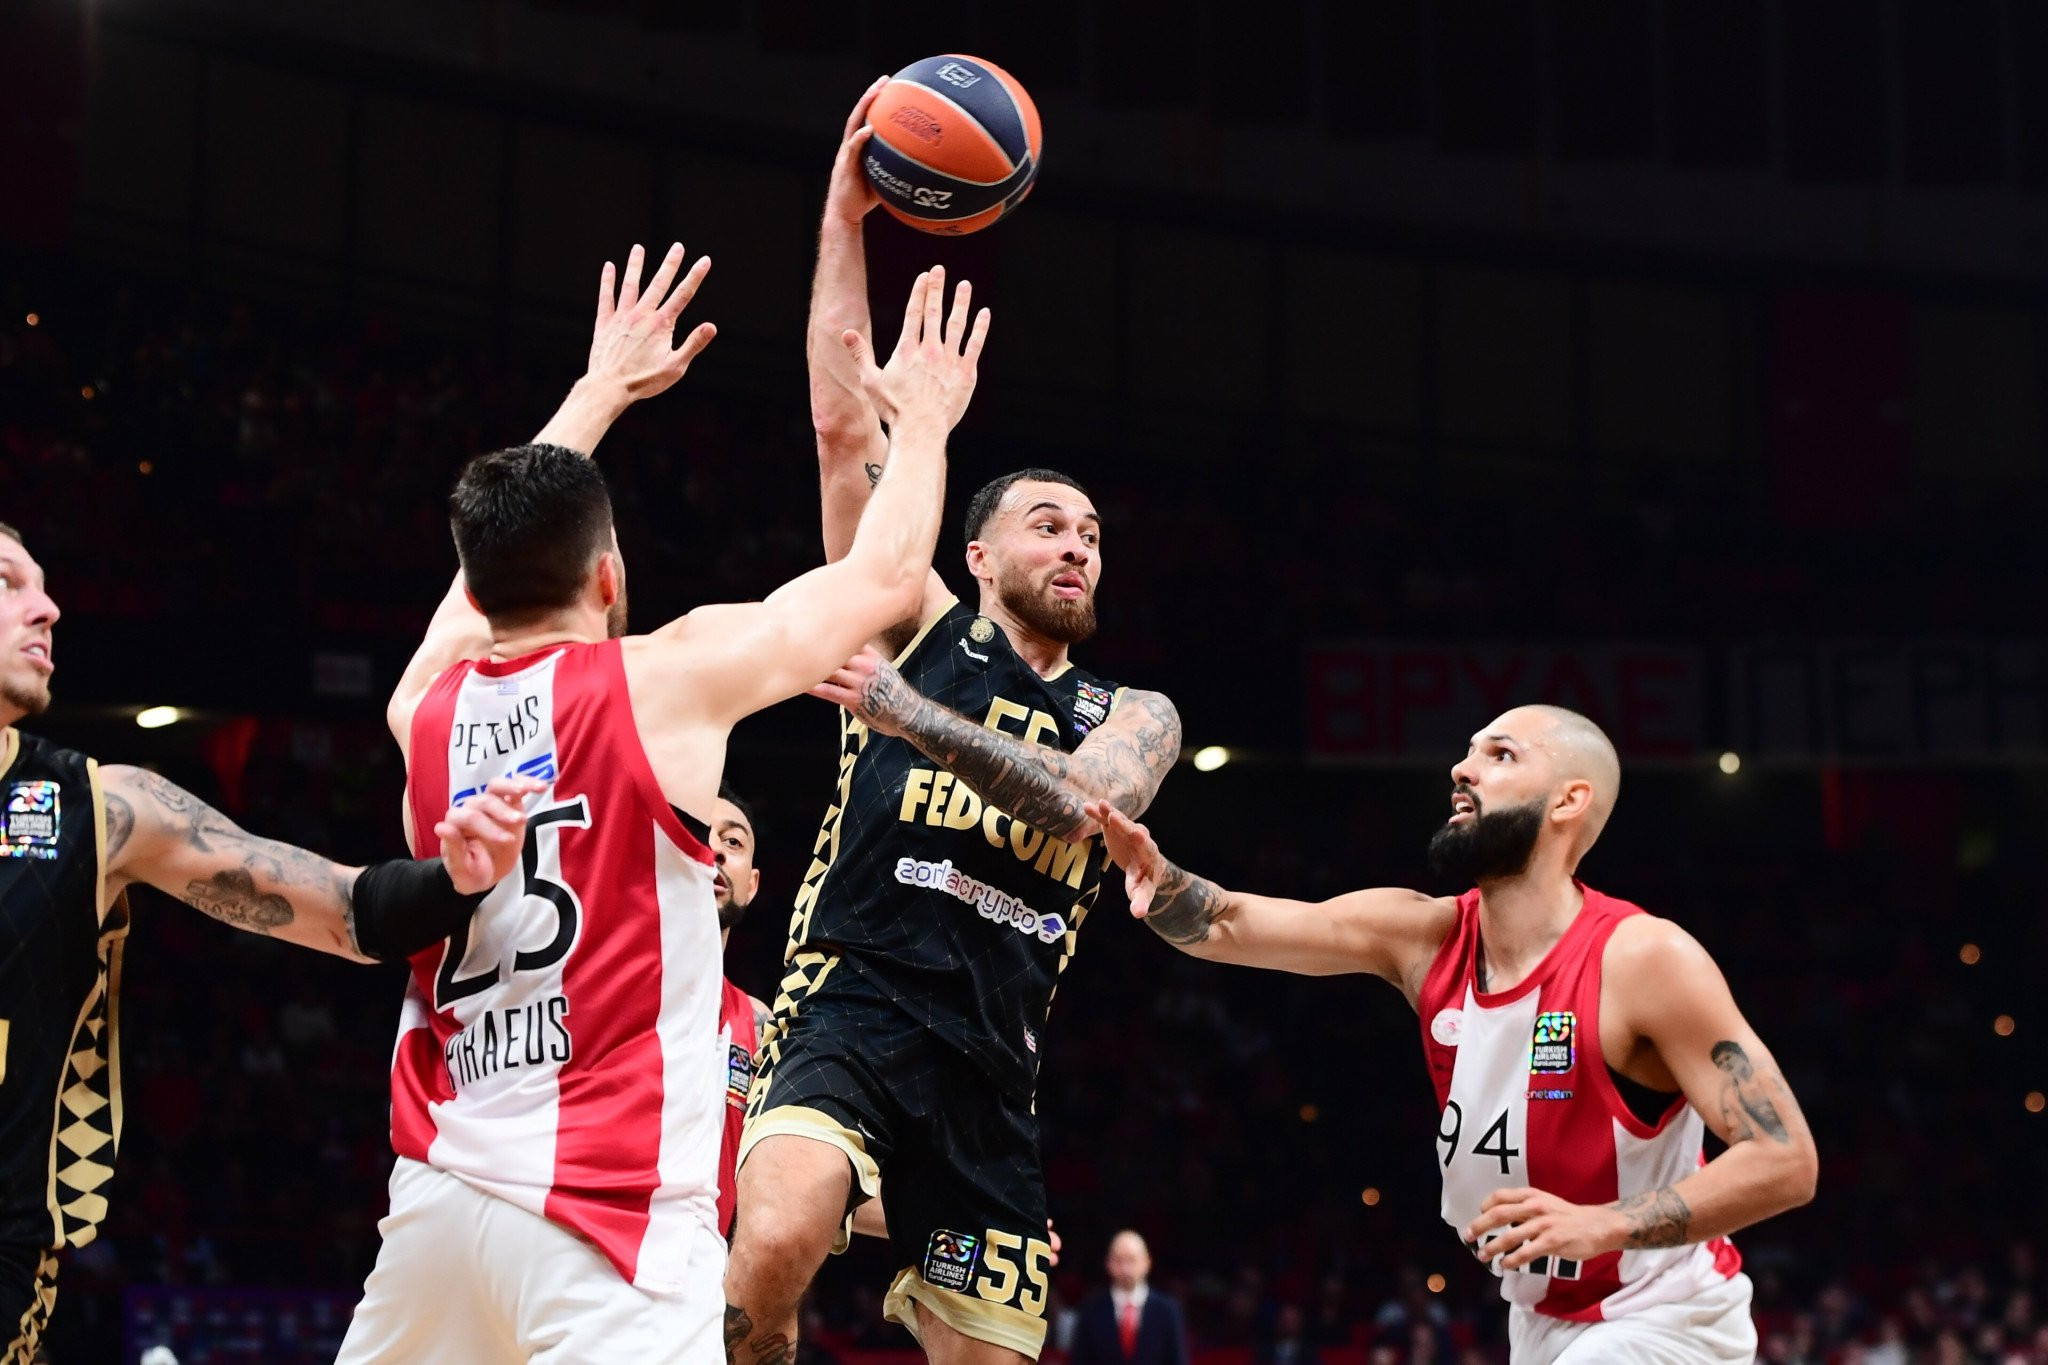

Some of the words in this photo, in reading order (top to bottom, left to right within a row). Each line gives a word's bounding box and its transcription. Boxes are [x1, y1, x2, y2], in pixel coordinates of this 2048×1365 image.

[899, 768, 1093, 890] FEDCOM
[445, 996, 570, 1091] PIRAEUS
[1535, 1016, 1569, 1043] 25
[1534, 1053, 1568, 1061] AIRLINES
[1535, 1046, 1568, 1054] TURKISH
[1436, 1100, 1520, 1176] 94
[933, 1234, 975, 1263] 25
[929, 1266, 965, 1281] AIRLINES
[931, 1259, 967, 1275] TURKISH
[976, 1228, 1051, 1317] 55
